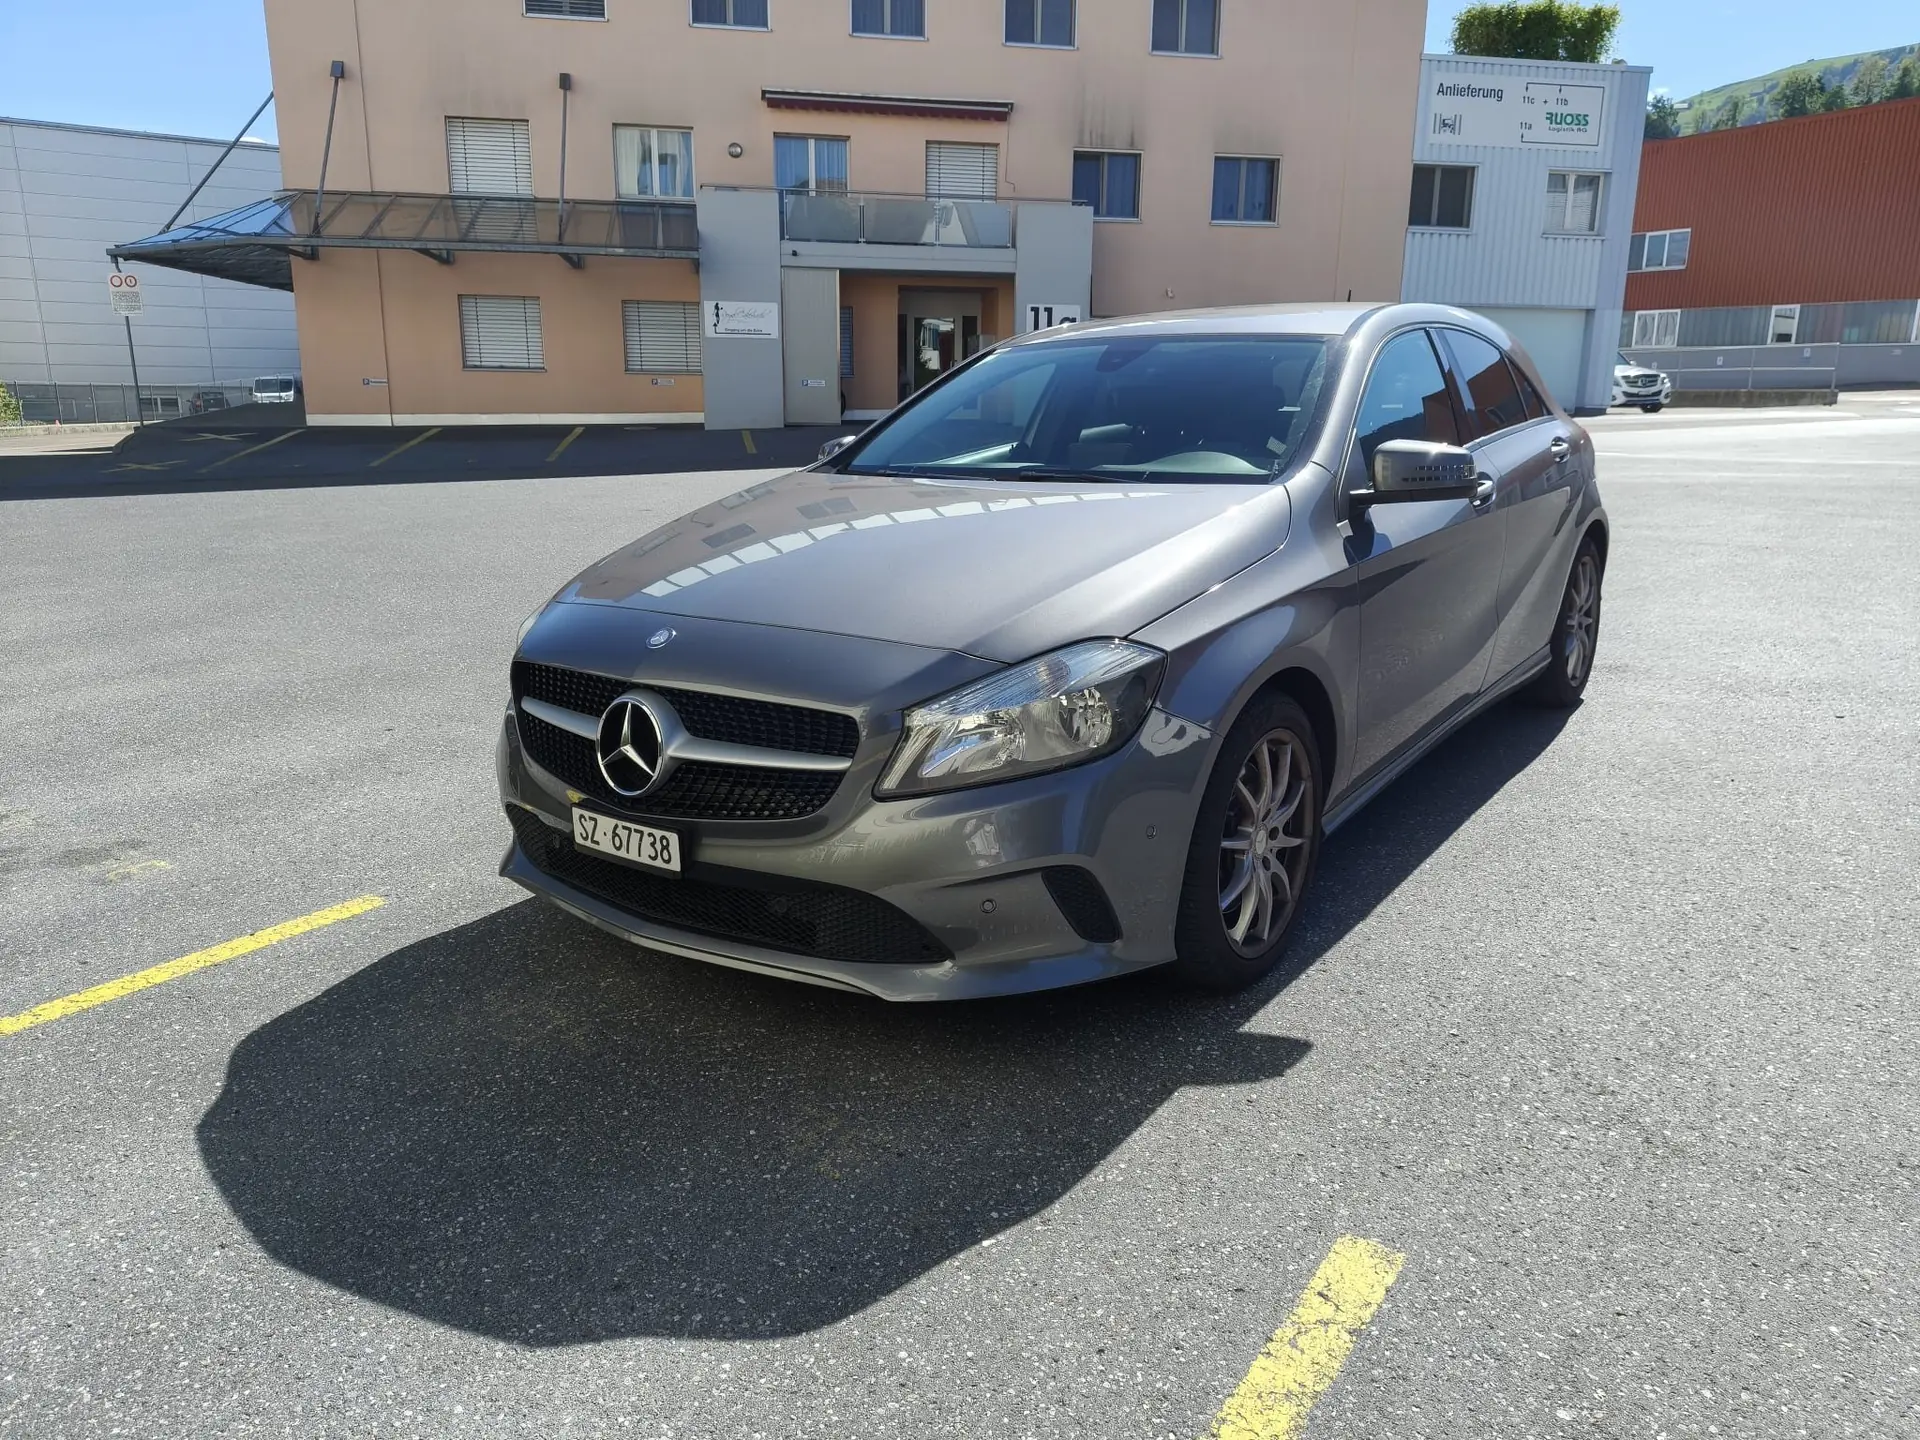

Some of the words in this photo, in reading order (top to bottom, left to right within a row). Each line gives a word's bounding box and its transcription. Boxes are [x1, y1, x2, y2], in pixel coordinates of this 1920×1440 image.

[1436, 82, 1503, 102] Anlieferung
[1522, 95, 1535, 105] 11c
[1555, 97, 1568, 106] 11b
[1520, 121, 1532, 130] 11a
[1545, 112, 1589, 127] RUOSS
[578, 813, 600, 846] SZ
[611, 823, 672, 864] 67738
